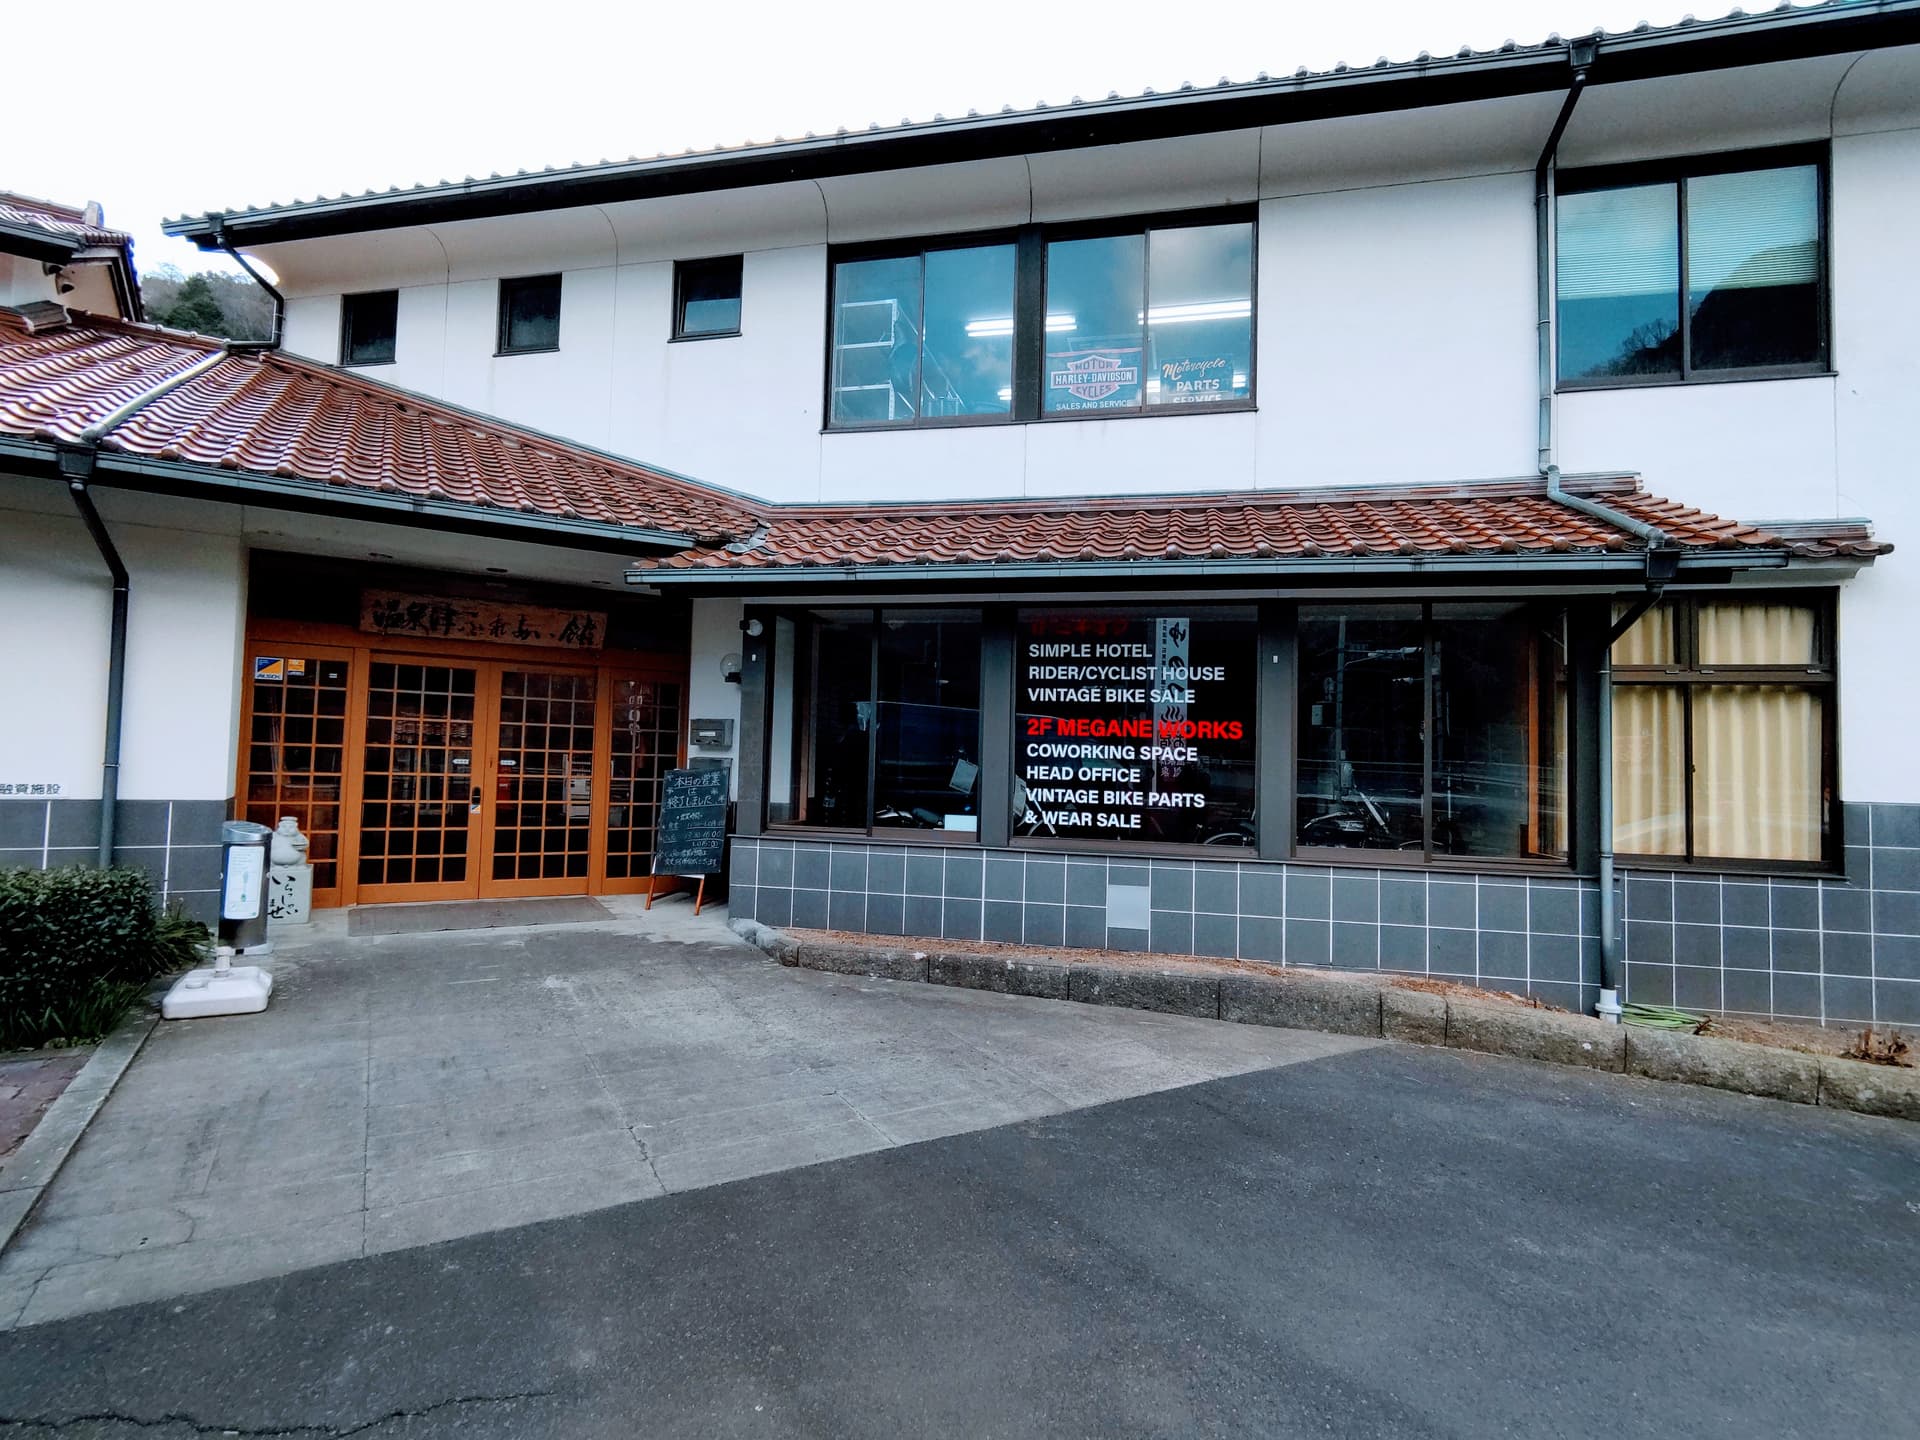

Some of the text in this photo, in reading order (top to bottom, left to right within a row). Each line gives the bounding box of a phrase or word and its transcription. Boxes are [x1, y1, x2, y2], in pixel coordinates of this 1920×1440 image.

[1075, 357, 1113, 371] MOTOR
[1162, 358, 1226, 380] Motorcycle
[1055, 371, 1132, 385] HARLEY-DAVIDSON
[1176, 378, 1220, 392] PARTS
[1075, 384, 1112, 398] CYCLES
[1056, 399, 1131, 411] SALES AND SERVIC
[1029, 644, 1153, 658] SIMPLE HOTEL
[1029, 666, 1225, 681] RIDER/CYCLIST HOUSE
[1028, 687, 1196, 704] VINTAGE BIKE SALE
[1027, 717, 1244, 740] 2F MEGANE WORKS
[1026, 743, 1198, 762] COWORKING SPACE
[1026, 766, 1074, 780] HEAD
[1078, 767, 1141, 783] OFFICE
[1026, 788, 1206, 808] VINTAGE BIKE PARTS
[1024, 810, 1141, 828] & WEAR SALE
